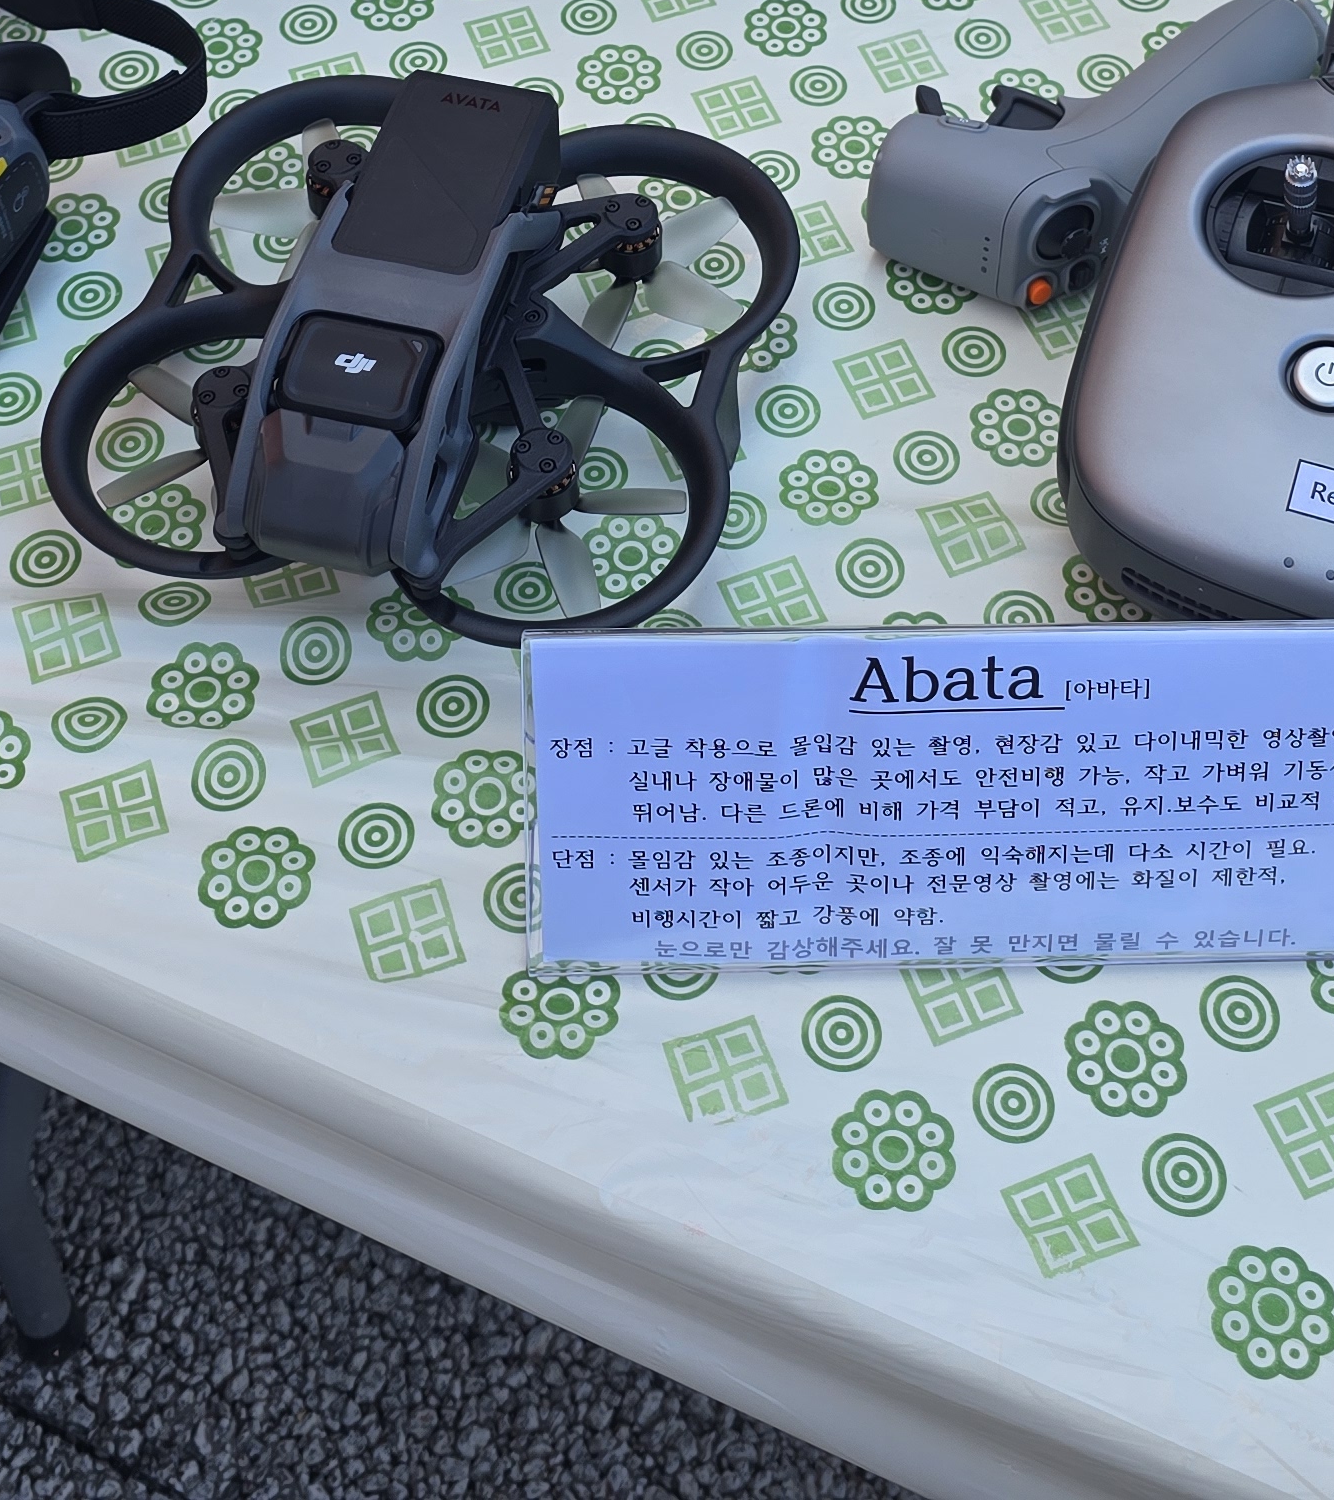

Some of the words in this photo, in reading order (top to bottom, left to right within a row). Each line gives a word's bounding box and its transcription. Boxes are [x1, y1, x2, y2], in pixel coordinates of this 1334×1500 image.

[439, 91, 503, 114] AVATA
[849, 656, 1044, 704] Abata
[1066, 679, 1151, 701] [아바타]
[549, 737, 593, 759] 장점
[626, 738, 674, 759] 고글
[684, 737, 778, 759] 착용으로
[789, 732, 858, 757] 몰입감
[871, 737, 916, 758] 있는
[927, 734, 980, 756] 촬영,
[994, 732, 1064, 755] 현장감
[1076, 732, 1121, 754] 있고
[1134, 728, 1249, 752] 다이내믹한
[628, 770, 698, 792] 실내나
[708, 769, 798, 793] 장애물이
[813, 765, 858, 789] 많은
[869, 768, 962, 791] 곳에서도
[975, 766, 1065, 788] 안전비행
[1078, 765, 1130, 786] 가능,
[1143, 763, 1190, 785] 작고
[1202, 760, 1269, 783] 가벼워
[632, 802, 707, 824] 뛰어남.
[720, 802, 767, 824] 다른
[778, 797, 844, 820] 드론에
[858, 800, 902, 822] 비해
[916, 799, 959, 821] 가격
[973, 797, 1040, 820] 부담이
[1055, 797, 1106, 818] 적고,
[1119, 794, 1242, 817] 유지.보수도
[1255, 790, 1320, 813] 비교적
[552, 848, 594, 869] 단점
[709, 850, 754, 871] 있는
[765, 843, 885, 868] 조종이지만,
[898, 846, 965, 868] 조종에
[980, 843, 1114, 866] 익숙해지는데
[1128, 842, 1174, 863] 다소
[1185, 839, 1251, 861] 시간이
[1265, 838, 1316, 859] 필요.
[629, 876, 697, 897] 센서가
[708, 877, 755, 898] 작아
[767, 871, 834, 896] 어두운
[845, 873, 915, 895] 곳이나
[926, 872, 1018, 894] 전문영상
[1028, 870, 1120, 892] 촬영에는
[1131, 868, 1198, 890] 화질이
[1211, 865, 1285, 887] 제한적,
[631, 909, 741, 930] 비행시간이
[755, 909, 802, 930] 짧고
[812, 904, 879, 928] 강풍에
[893, 906, 944, 927] 약함.
[654, 939, 753, 960] 눈으로만
[766, 936, 920, 961] 감상해주세요.
[933, 935, 957, 956] 잘
[970, 935, 993, 955] 못
[1008, 933, 1078, 953] 만지면
[1093, 931, 1140, 952] 물릴
[1155, 931, 1180, 950] 수
[1193, 927, 1296, 949] 있습니다.
